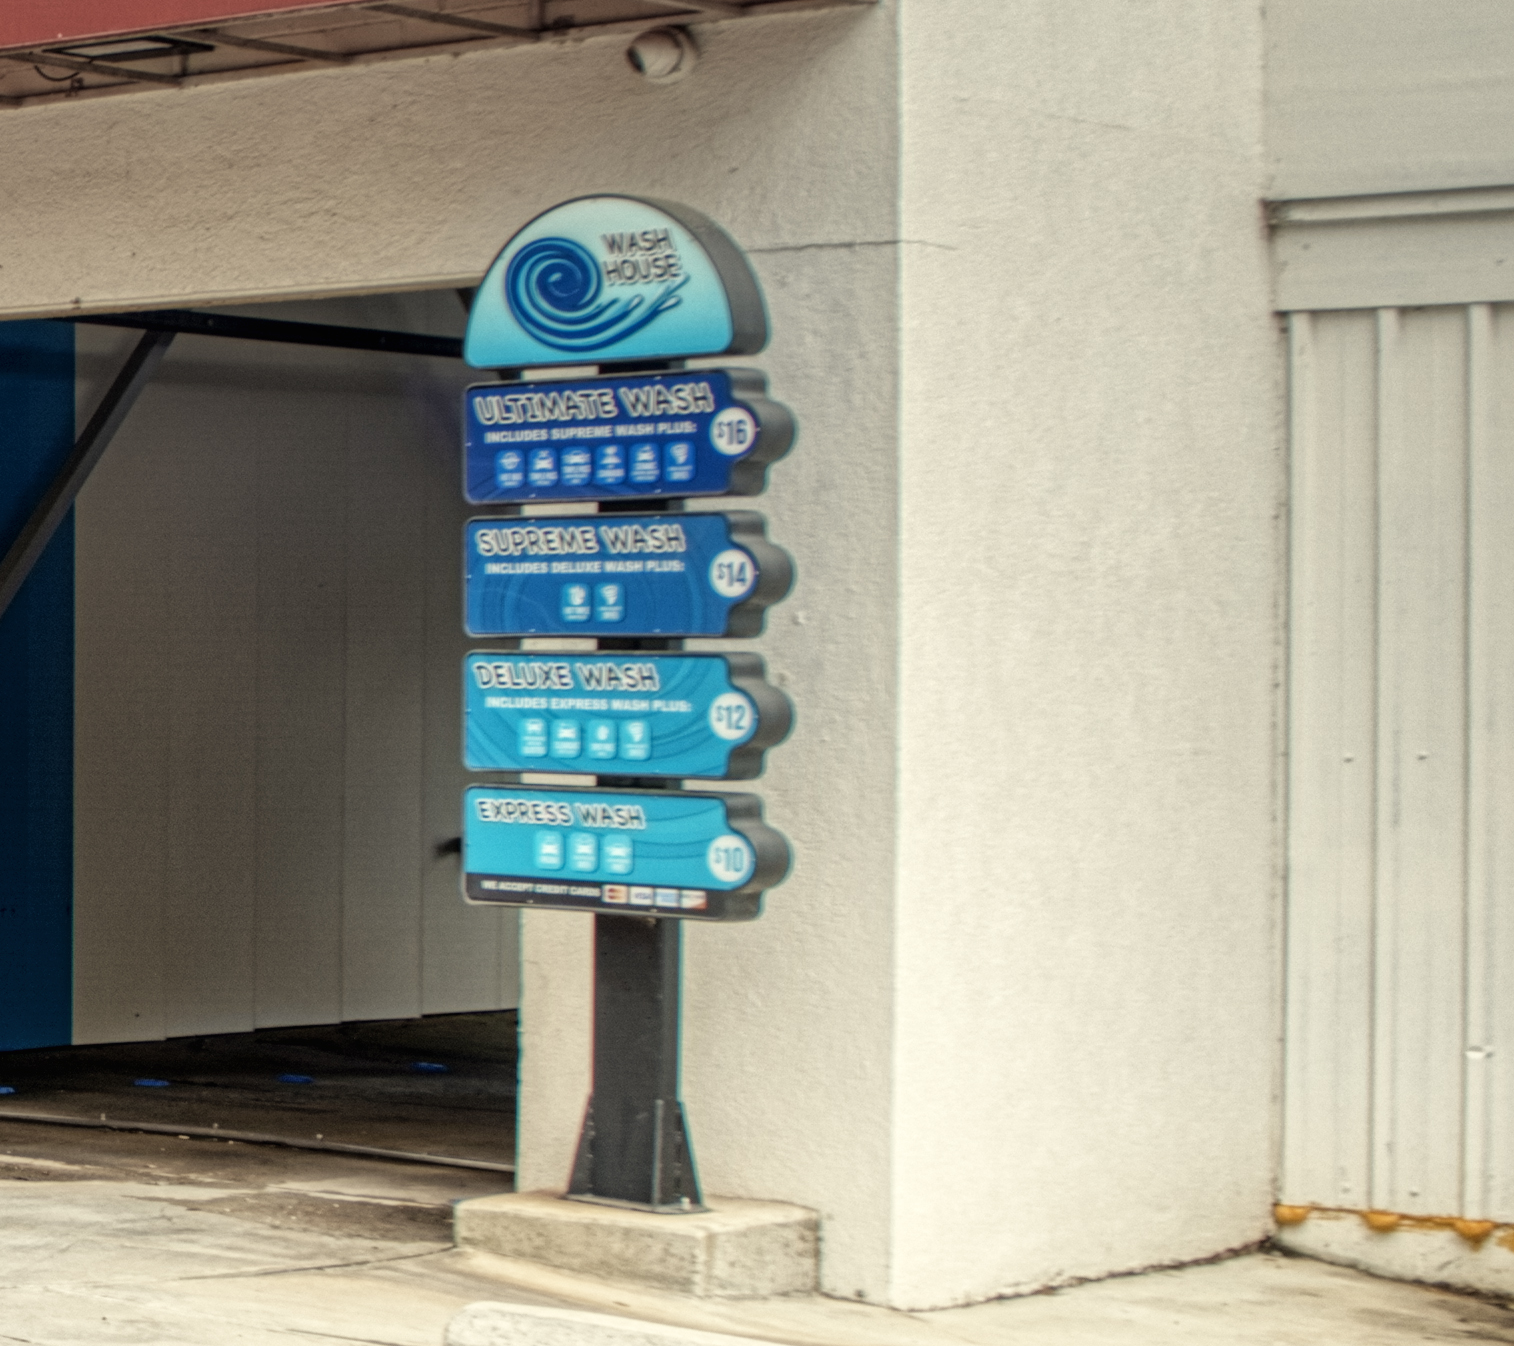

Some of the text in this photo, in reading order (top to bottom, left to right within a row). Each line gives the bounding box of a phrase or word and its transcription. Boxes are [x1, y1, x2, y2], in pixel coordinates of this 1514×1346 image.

[602, 228, 677, 256] WASH
[604, 254, 682, 286] HOUSE
[474, 382, 715, 425] ULTIMATE WASH
[484, 421, 697, 444] INCLUDES SUPREME WASH PLUS:
[716, 419, 749, 446] $16
[476, 524, 686, 556] SUPREME WASH
[484, 560, 685, 575] INCLUDES DELUXE WASH PLUS:
[716, 561, 748, 587] $14
[473, 662, 660, 691] DELUXE WASH
[485, 696, 549, 709] INCLUDES
[551, 697, 609, 711] EXPRESS
[611, 698, 650, 711] WASH
[715, 704, 747, 731] $12
[475, 798, 647, 829] EXPRESS WASH
